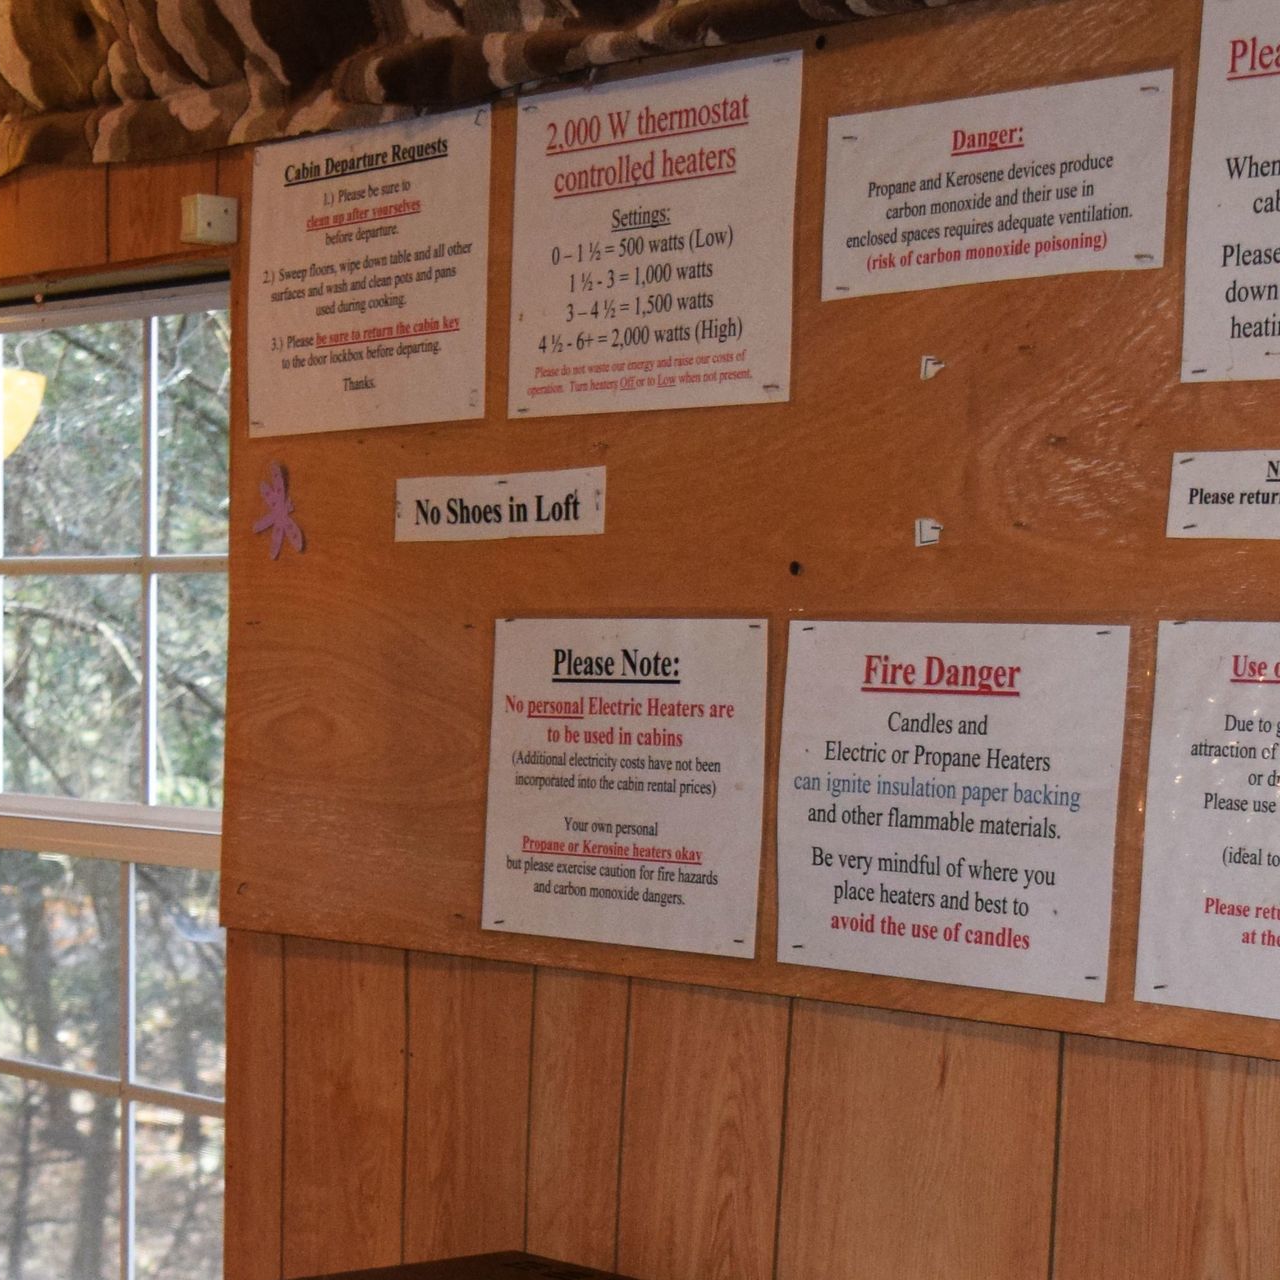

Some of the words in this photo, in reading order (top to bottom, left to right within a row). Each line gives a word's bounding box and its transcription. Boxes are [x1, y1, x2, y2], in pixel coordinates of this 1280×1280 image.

[544, 113, 603, 152] 2,000
[605, 108, 632, 141] W
[635, 92, 750, 137] thermostat
[950, 125, 1024, 154] Danger:
[282, 158, 322, 184] Cabin
[323, 148, 389, 177] Departure
[389, 134, 449, 164] Requests
[552, 148, 656, 195] controlled
[659, 145, 737, 179] heaters
[866, 179, 917, 201] Propane
[917, 170, 943, 192] and
[944, 167, 1005, 189] Kerosene
[1005, 159, 1057, 181] devices
[1057, 151, 1115, 180] produce
[609, 203, 672, 230] Settings:
[883, 199, 927, 221] carbon
[928, 190, 993, 216] monoxide
[993, 186, 1019, 208] and
[1020, 183, 1053, 205] their
[1054, 184, 1079, 201] use
[1080, 178, 1095, 198] in
[323, 228, 354, 247] before
[353, 223, 400, 244] departure.
[844, 225, 899, 250] enclosed
[899, 225, 941, 248] spaces
[942, 216, 995, 242] requires
[995, 211, 1055, 235] adequate
[1056, 201, 1134, 226] ventilation.
[277, 266, 309, 283] Sweep
[337, 258, 362, 276] wipe
[360, 253, 388, 270] down
[387, 247, 413, 266] table
[411, 243, 432, 262] and
[431, 241, 446, 259] all
[445, 239, 473, 257] other
[865, 250, 897, 273] (risk
[898, 248, 915, 268] of
[914, 245, 962, 266] carbon
[963, 236, 1032, 261] monoxide
[1032, 229, 1108, 259] poisoning)
[313, 299, 337, 318] used
[335, 298, 367, 315] during
[412, 497, 442, 527] No
[444, 495, 504, 526] Shoes
[506, 493, 529, 524] in
[532, 486, 581, 523] Loft
[1186, 486, 1236, 506] Please
[550, 646, 616, 677] Please
[618, 646, 681, 678] Note:
[861, 652, 917, 687] Fire
[921, 654, 1023, 697] Danger
[1231, 653, 1269, 679] Use
[503, 692, 525, 714] No
[526, 694, 585, 720] personal
[586, 694, 643, 717] Electric
[645, 696, 706, 718] Heaters
[707, 702, 735, 719] are
[885, 709, 954, 735] Candles
[955, 712, 989, 737] and
[545, 725, 562, 744] to
[562, 723, 581, 745] be
[581, 724, 615, 746] used
[617, 724, 633, 746] in
[634, 726, 684, 748] cabins
[510, 748, 567, 767] (Additional
[566, 750, 618, 773] electricity
[618, 755, 646, 771] costs
[646, 753, 674, 772] have
[673, 757, 693, 772] not
[693, 755, 722, 774] been
[822, 738, 888, 764] Electric
[889, 747, 911, 765] or
[911, 742, 982, 774] Propane
[984, 746, 1052, 773] Heaters
[792, 774, 822, 792] can
[824, 769, 872, 799] ignite
[875, 772, 957, 800] insulation
[959, 783, 1010, 808] paper
[1011, 780, 1082, 814] backing
[562, 814, 590, 833] Your
[589, 820, 614, 835] own
[613, 820, 659, 839] personal
[806, 801, 838, 824] and
[839, 803, 885, 827] other
[886, 804, 976, 834] flammable
[977, 814, 1062, 840] materials.
[520, 833, 566, 855] Propane
[566, 840, 580, 854] or
[580, 838, 631, 858] Kerosine
[630, 841, 673, 861] heaters
